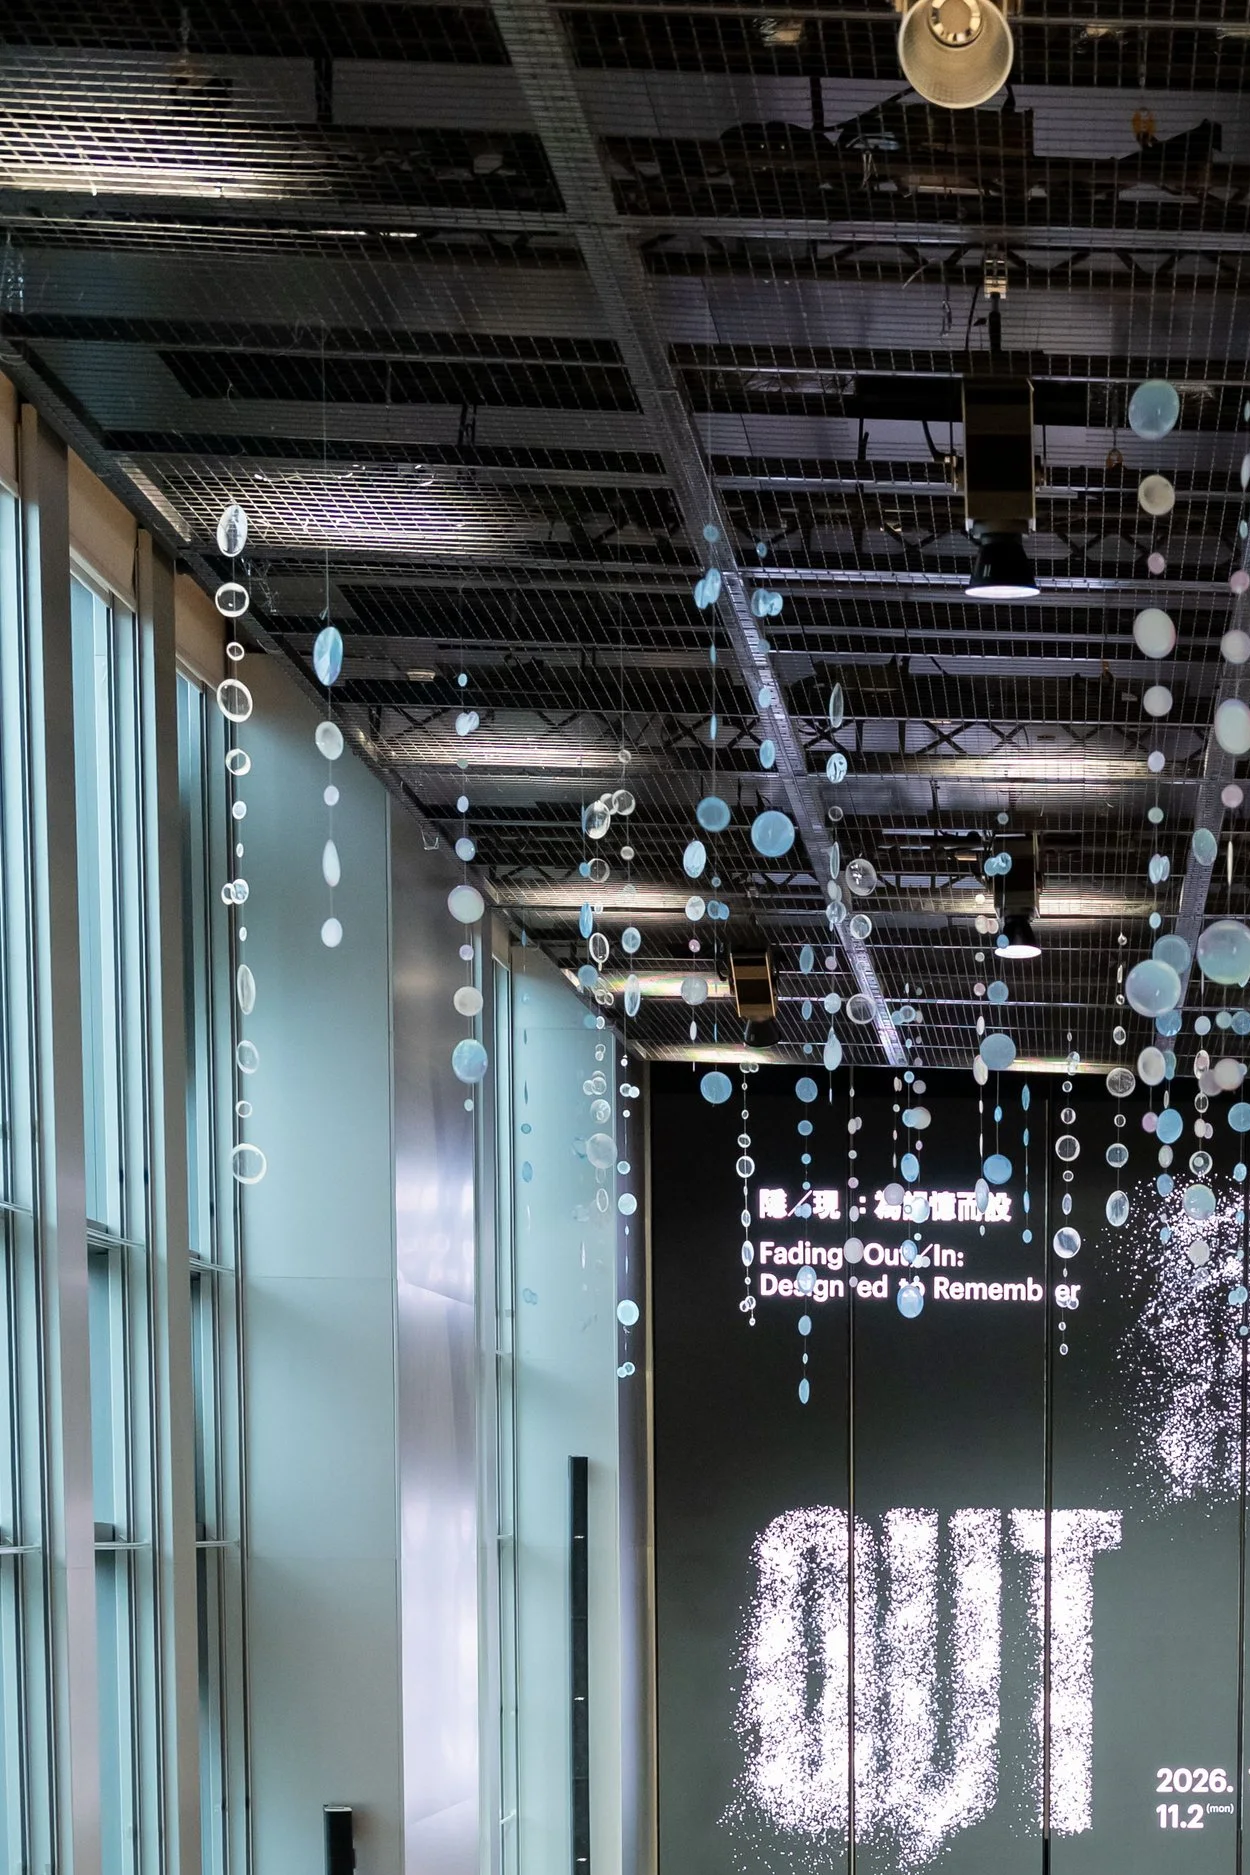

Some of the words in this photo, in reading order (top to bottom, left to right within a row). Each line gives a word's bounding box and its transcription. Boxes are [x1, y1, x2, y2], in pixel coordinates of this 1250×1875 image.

[760, 1241, 843, 1270] Fading
[760, 1273, 888, 1302] Desgned
[933, 1276, 1081, 1301] Remember
[1156, 1767, 1234, 1793] 2026.
[1156, 1803, 1204, 1829] 11.2
[1206, 1803, 1234, 1814] (mon)
